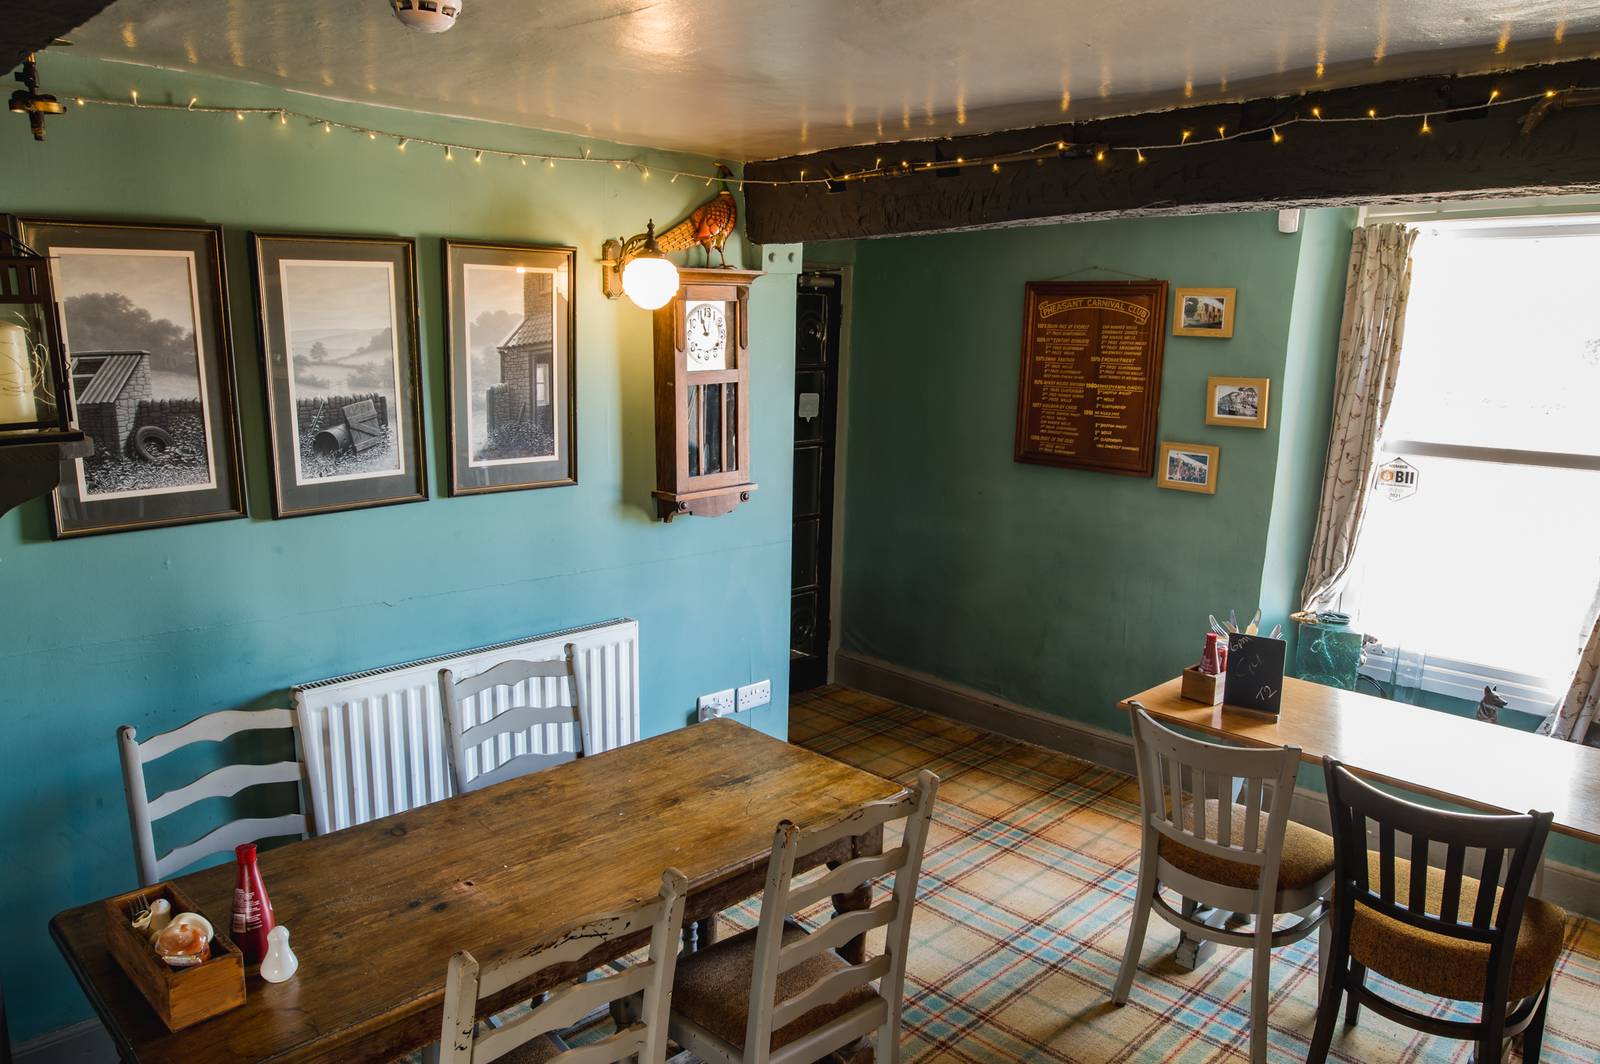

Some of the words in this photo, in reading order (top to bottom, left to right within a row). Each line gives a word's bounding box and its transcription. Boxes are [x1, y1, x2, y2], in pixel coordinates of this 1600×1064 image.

[1043, 299, 1083, 316] PHEASANT
[1087, 299, 1124, 311] CARNIVAL
[1128, 305, 1147, 317] CLUB
